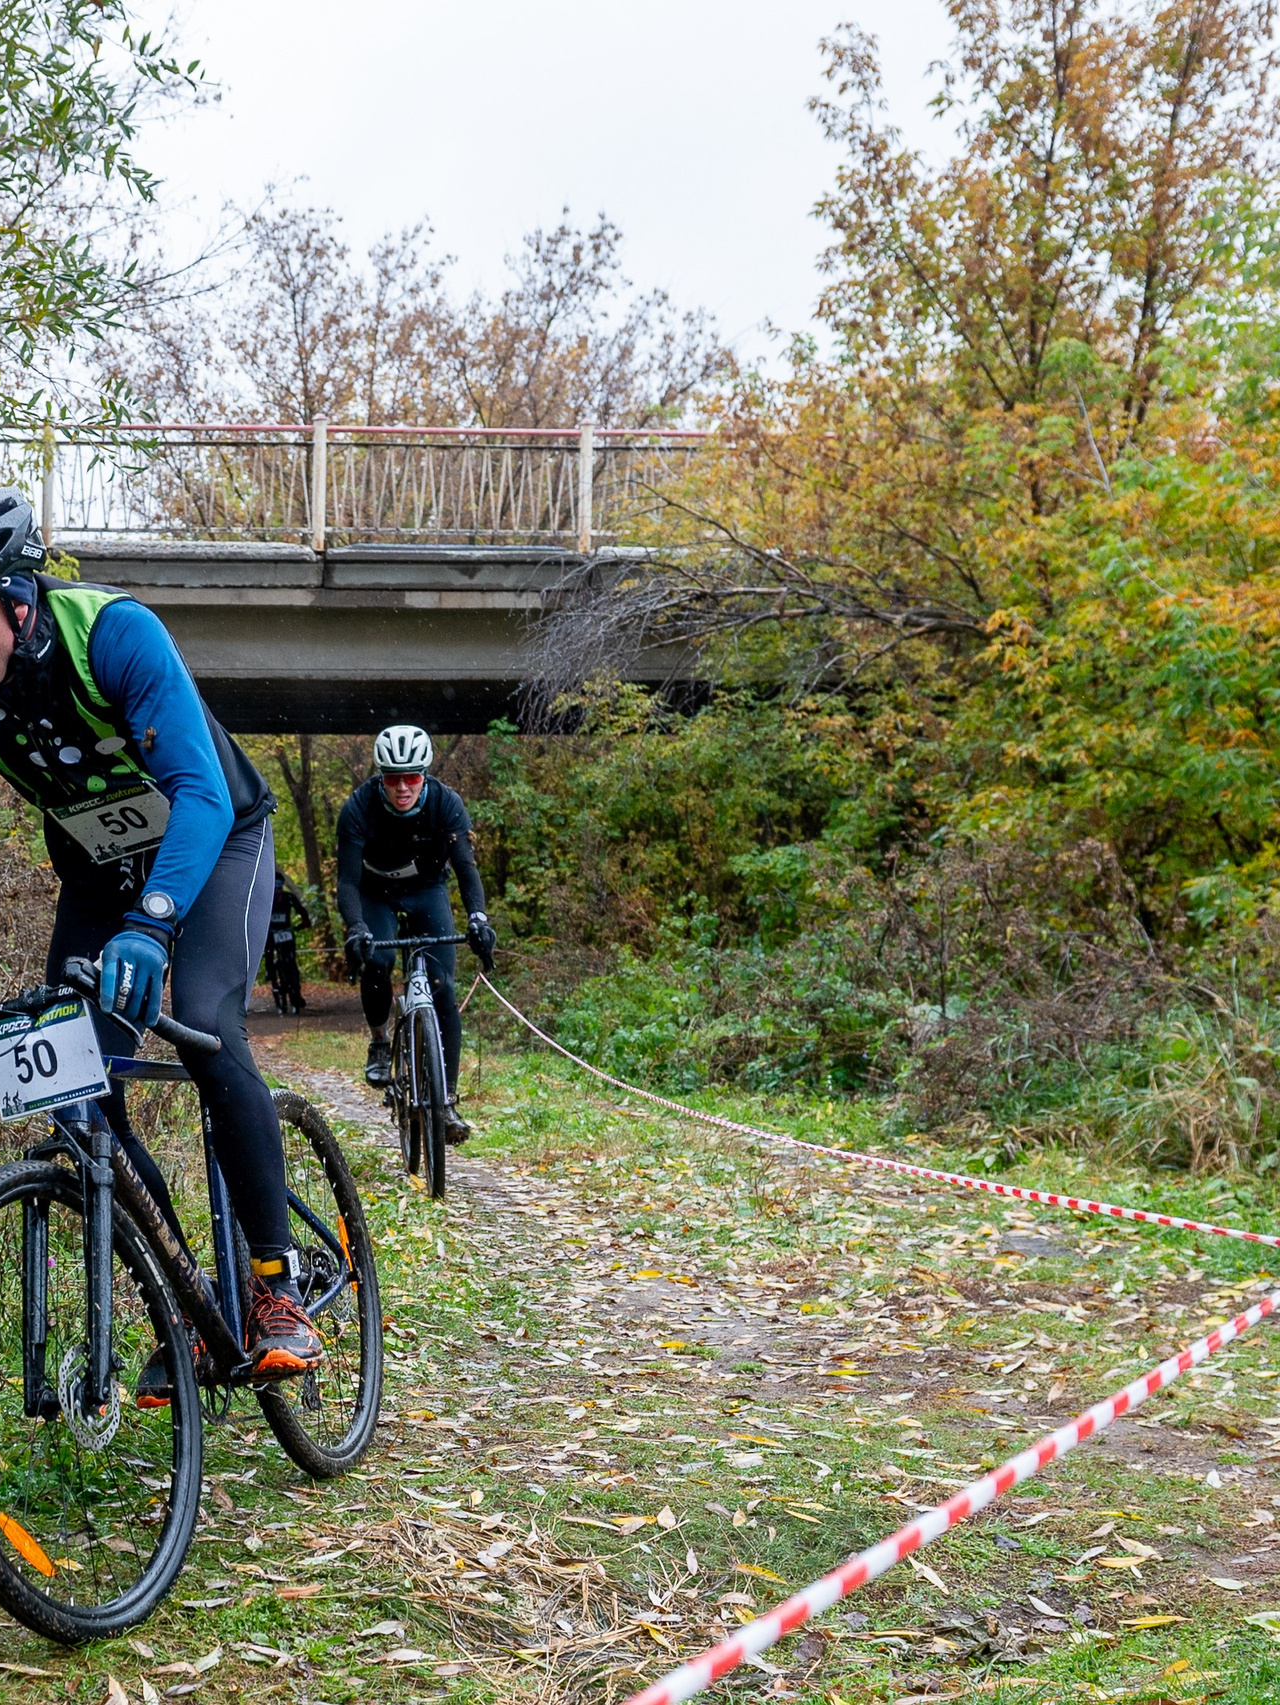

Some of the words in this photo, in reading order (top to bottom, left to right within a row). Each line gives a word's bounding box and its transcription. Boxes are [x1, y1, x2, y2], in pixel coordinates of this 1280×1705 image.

[21, 545, 43, 559] BBB
[68, 797, 102, 813] КРОСС
[106, 785, 145, 802] ДУАТЛОН
[97, 806, 148, 836] 50
[13, 1039, 58, 1084] 50
